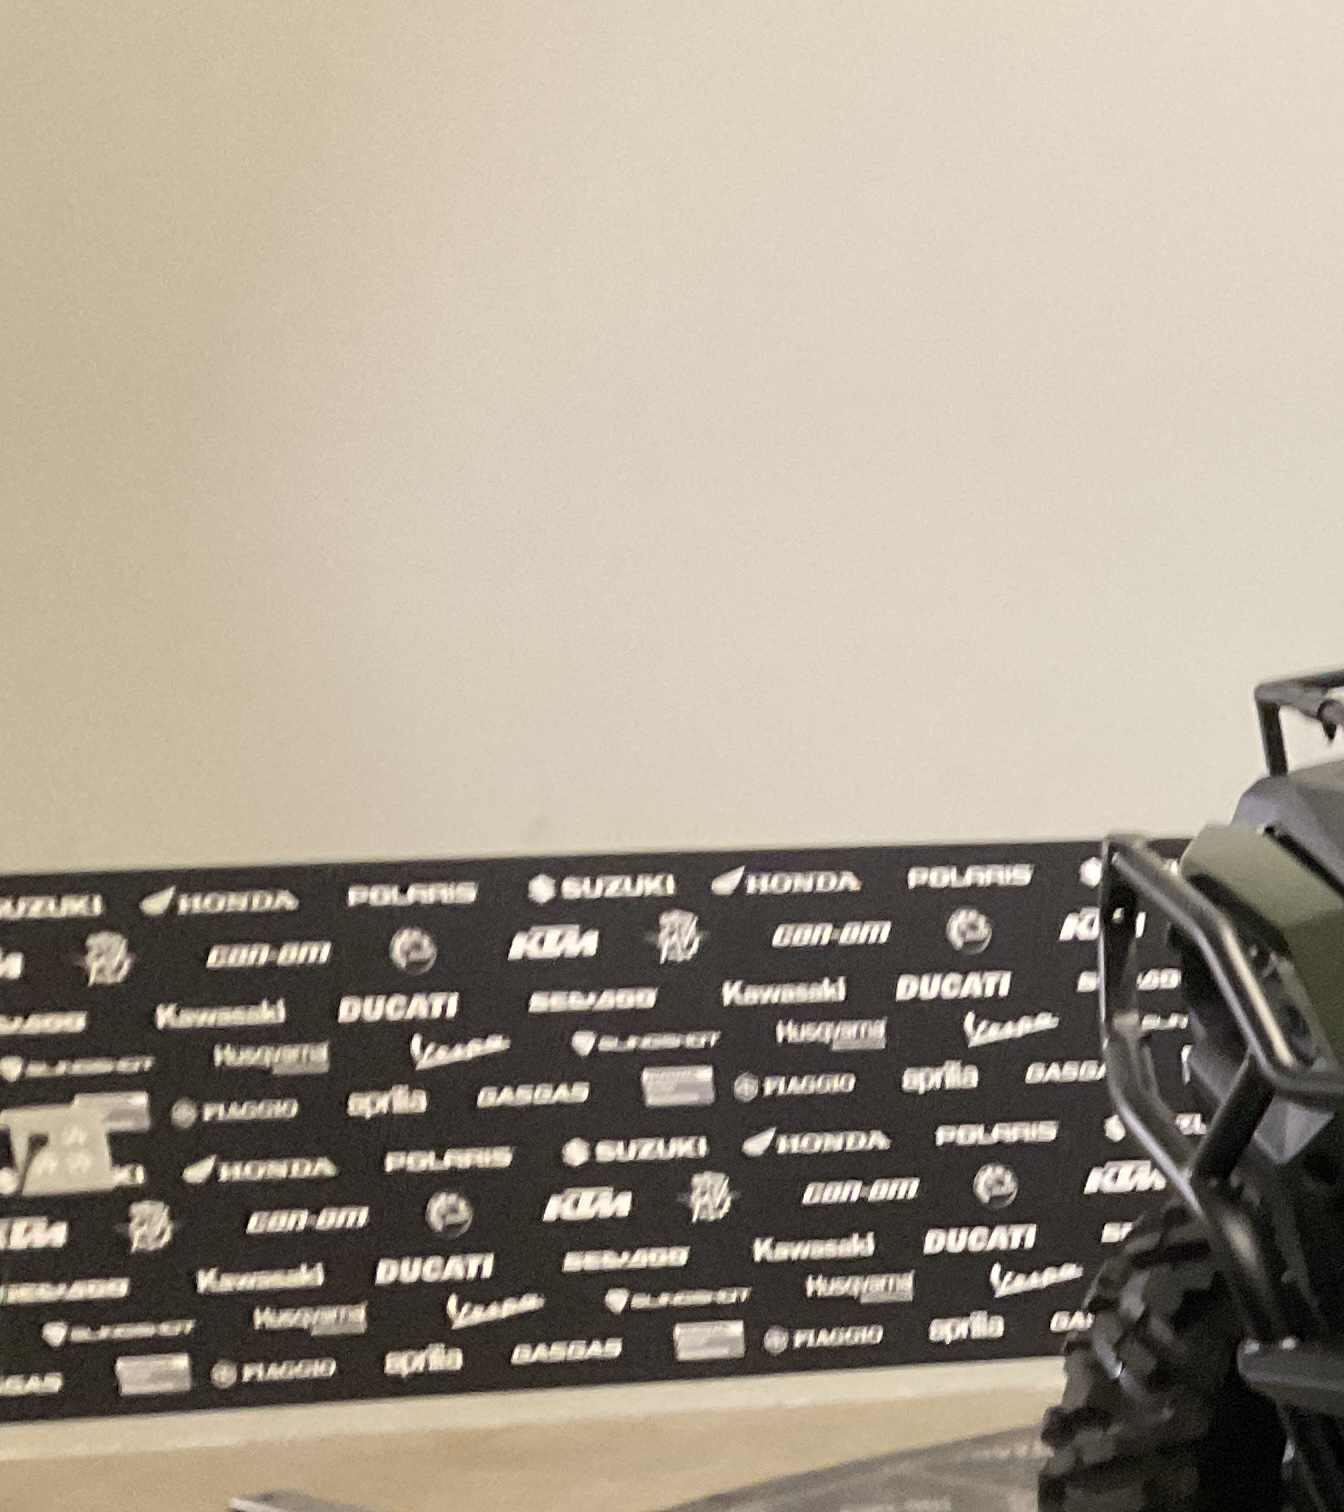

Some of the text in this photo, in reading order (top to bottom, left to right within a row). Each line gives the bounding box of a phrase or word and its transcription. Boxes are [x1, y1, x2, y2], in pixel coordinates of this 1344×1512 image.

[560, 872, 677, 901] SUZUKI
[743, 869, 863, 896] HONDA
[907, 863, 1034, 890] POLARIS
[0, 894, 103, 921] UZUKI
[177, 889, 300, 916] HONDA
[347, 881, 479, 907] POLARIS
[507, 923, 600, 961] KTM
[721, 975, 847, 1007] Kawasaki
[895, 970, 1012, 1002] DUCATI
[337, 991, 460, 1023] DUCATI
[762, 1072, 857, 1097] PIAGGIO
[901, 1059, 979, 1095] aprilia
[347, 1084, 428, 1120] aprilia
[476, 1081, 590, 1108] GASGAS
[202, 1098, 300, 1123] PIAGGIO
[775, 1129, 892, 1155] HONDA
[934, 1120, 1059, 1147] POLARIS
[384, 1146, 514, 1173] POLARIS
[593, 1135, 709, 1164] SUZUKI
[217, 1156, 337, 1183] HONDA
[542, 1186, 633, 1222] KTM
[752, 1231, 876, 1263] Kawasaki
[922, 1223, 1037, 1255] DUCATI
[196, 1262, 325, 1294] Kawasaki
[374, 1252, 495, 1285] DUCATI
[792, 1324, 885, 1350] PIAGGIO
[928, 1310, 1005, 1345] aprilia
[384, 1342, 464, 1378] aprilia
[510, 1337, 623, 1365] GASGAS
[241, 1358, 338, 1384] PIAGGIO
